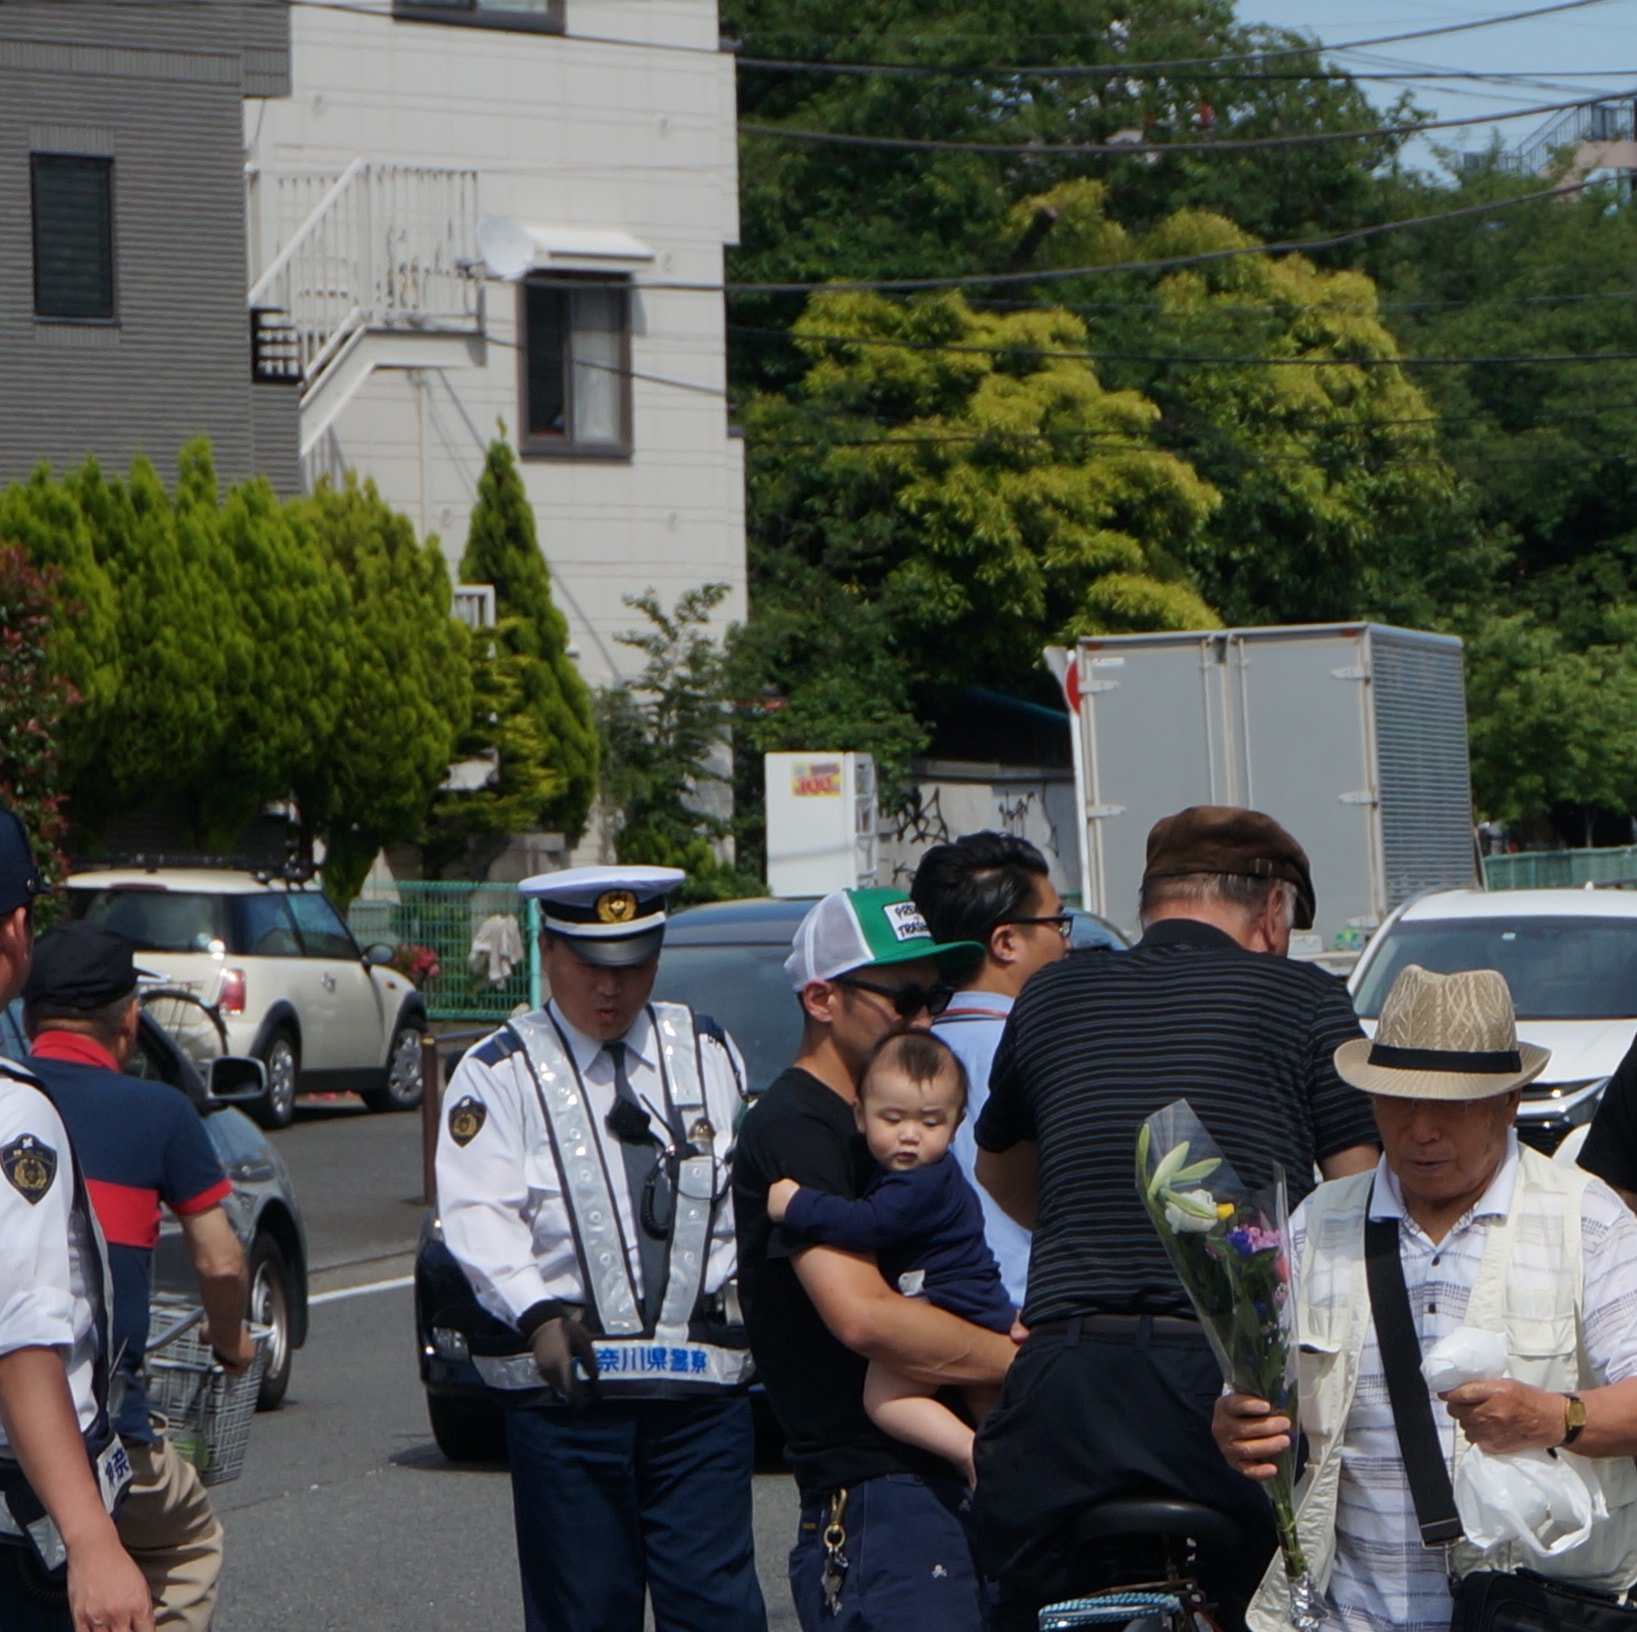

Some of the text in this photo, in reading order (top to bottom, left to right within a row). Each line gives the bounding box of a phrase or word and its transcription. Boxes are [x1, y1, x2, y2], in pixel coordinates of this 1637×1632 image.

[573, 1346, 708, 1373] 奈川県警察
